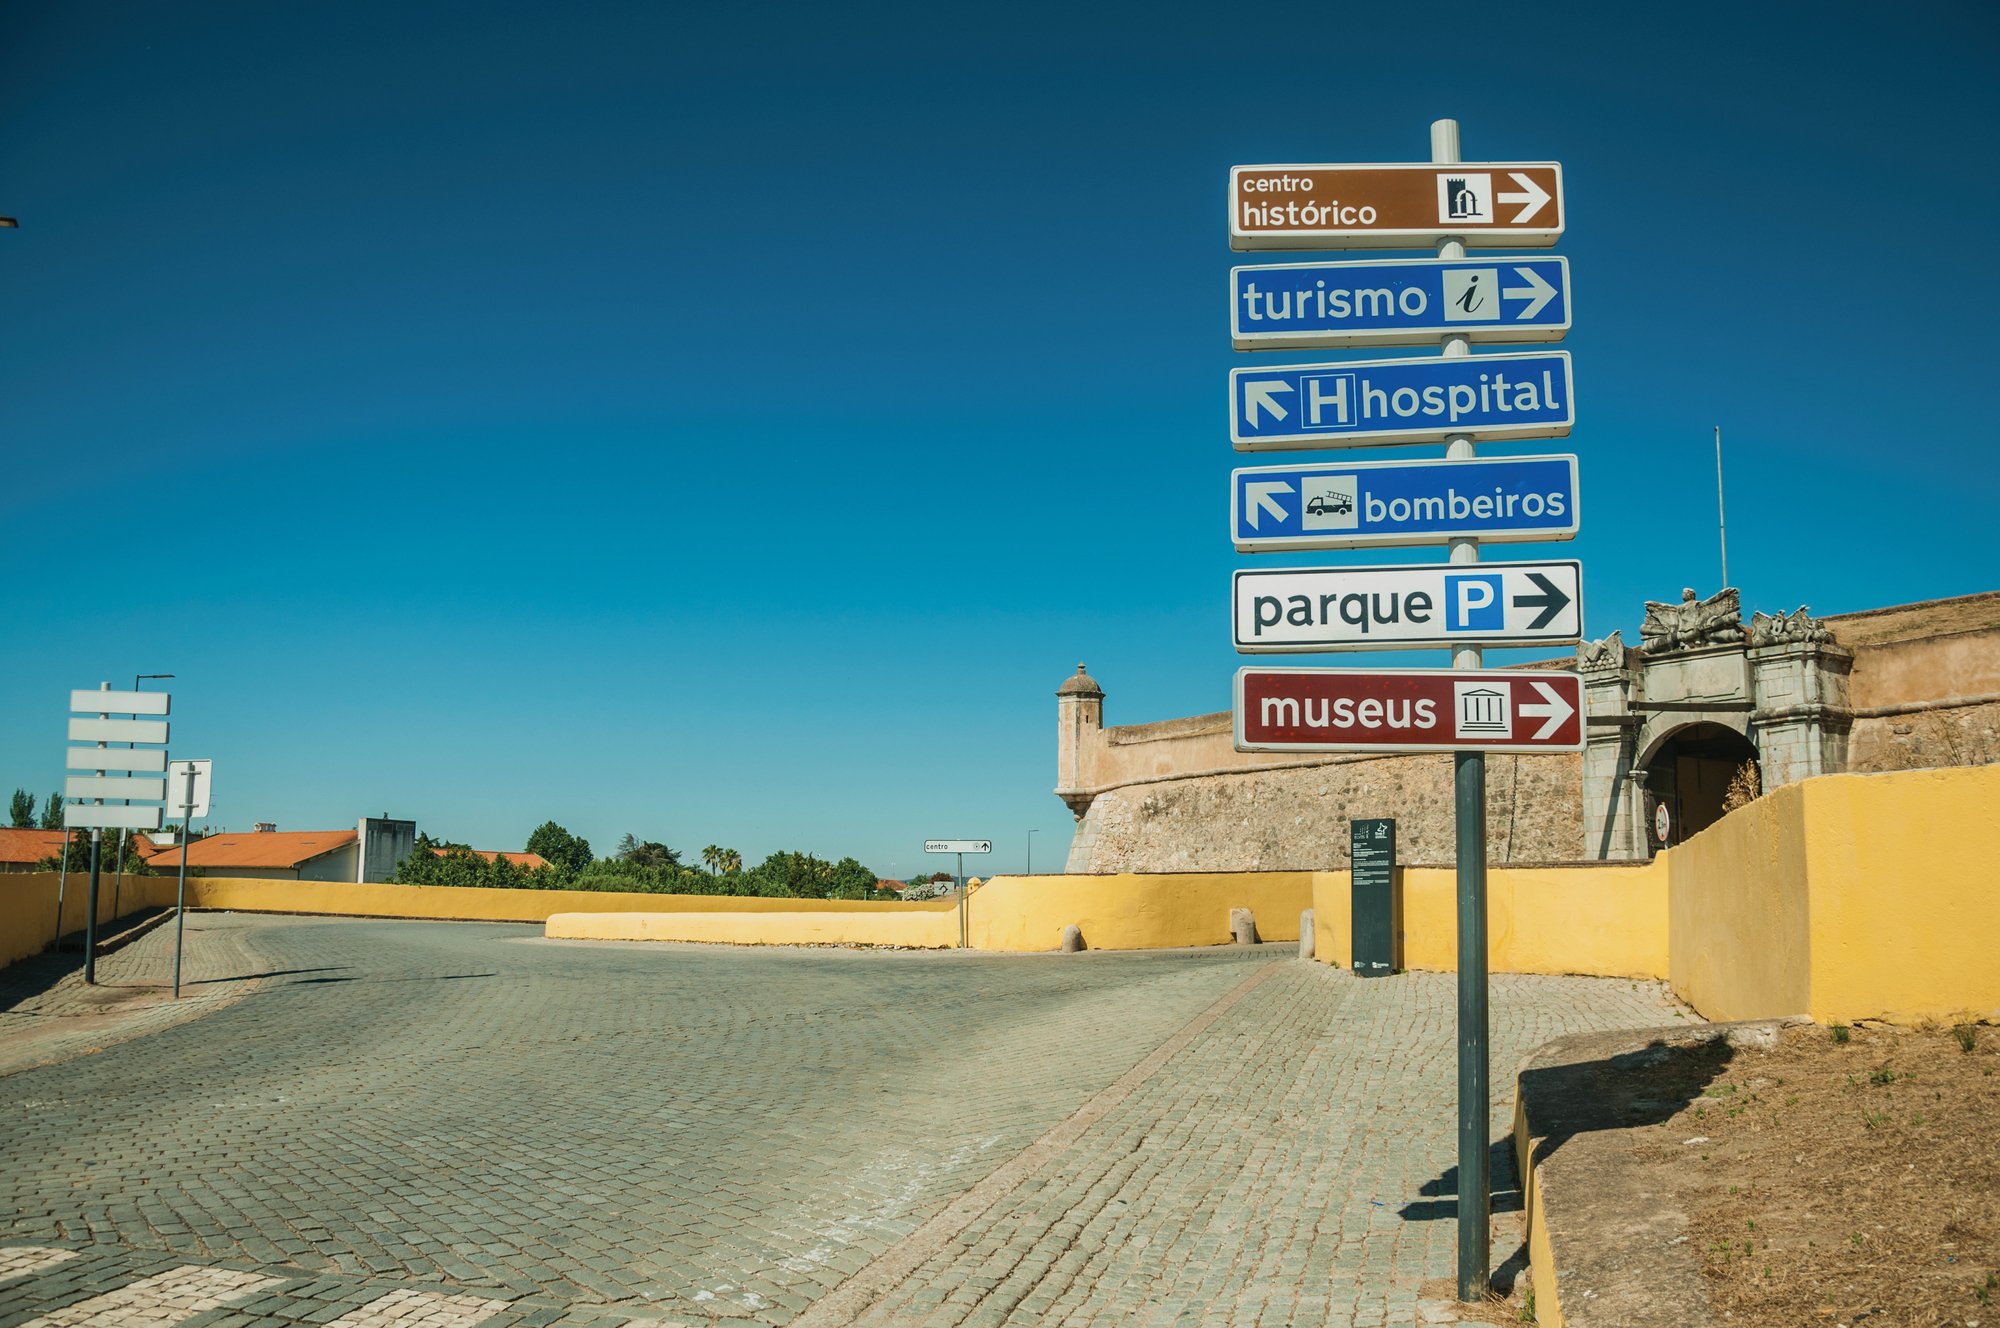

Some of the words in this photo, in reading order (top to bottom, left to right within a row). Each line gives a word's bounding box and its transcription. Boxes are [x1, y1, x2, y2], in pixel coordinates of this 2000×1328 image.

[1243, 174, 1314, 193] centro
[1243, 200, 1377, 227] histórico
[1242, 280, 1428, 320] turismo
[1456, 275, 1484, 313] i
[1309, 378, 1348, 424] H
[1362, 370, 1560, 422] hospital
[1365, 486, 1565, 523] bombeiros
[1253, 591, 1433, 636] parque
[1457, 580, 1495, 626] P
[1261, 697, 1437, 729] museus
